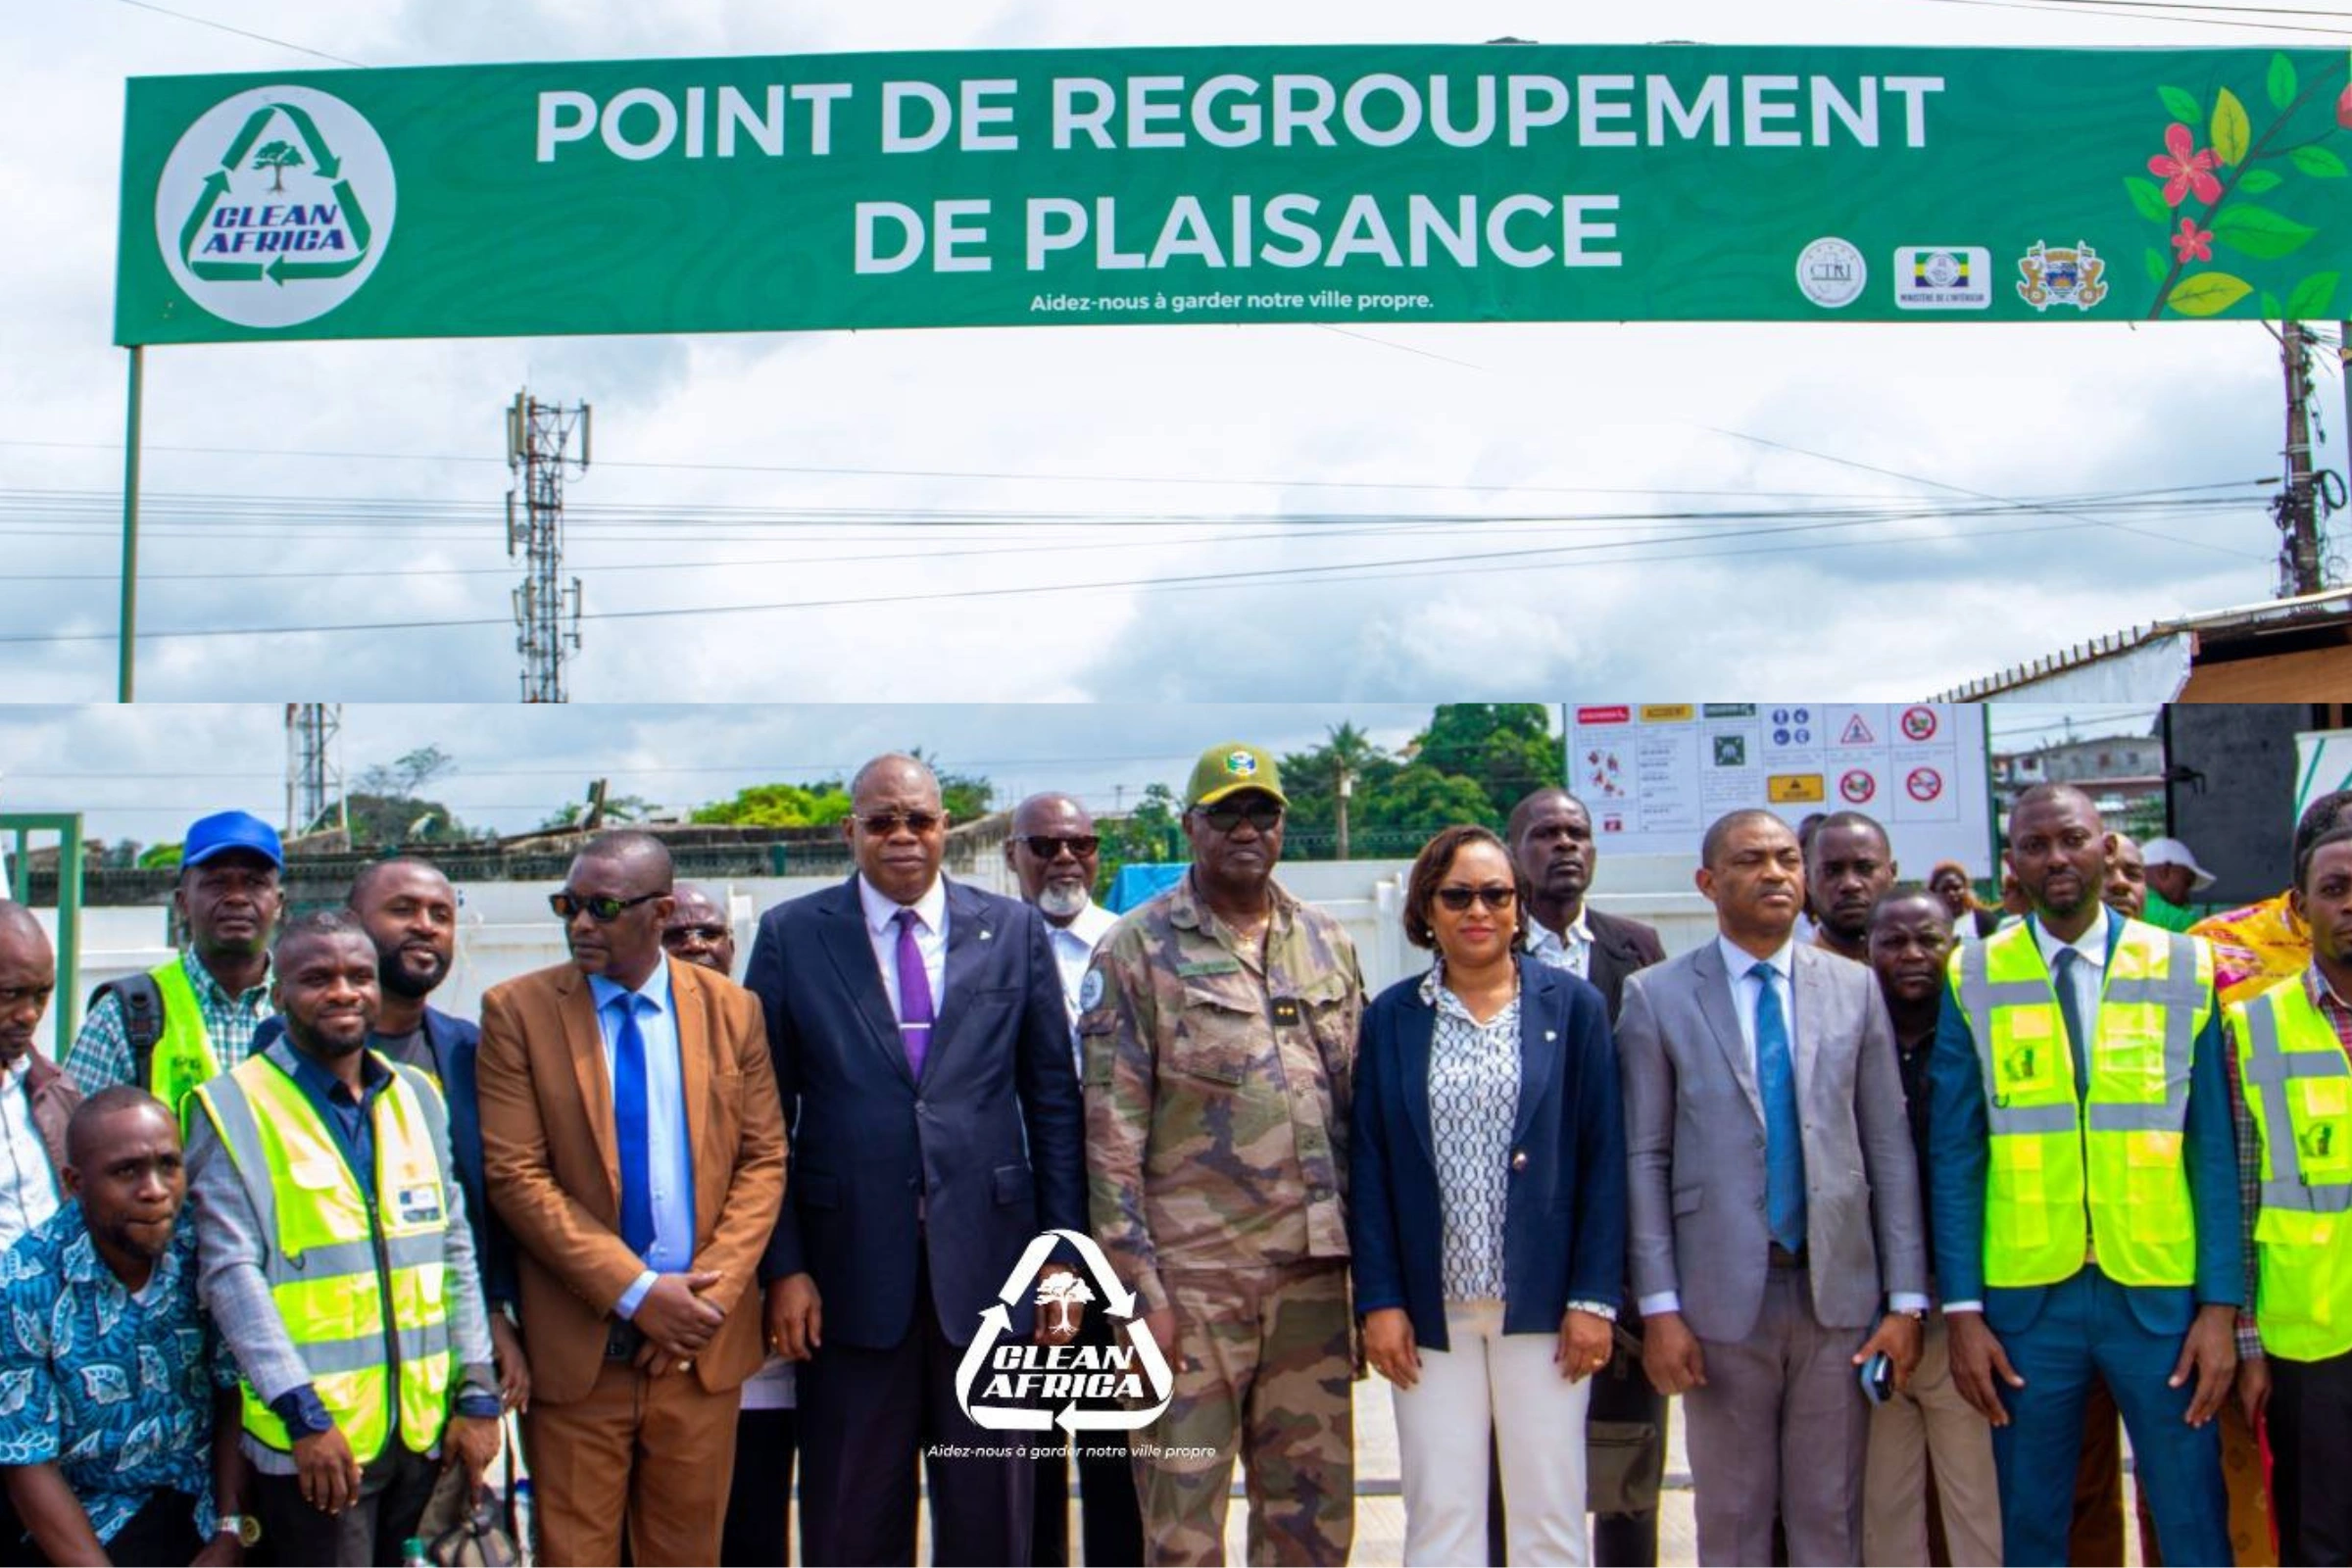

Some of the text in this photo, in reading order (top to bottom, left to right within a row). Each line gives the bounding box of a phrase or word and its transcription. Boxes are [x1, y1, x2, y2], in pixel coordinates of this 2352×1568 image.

[537, 73, 1945, 162] POINT DE REGROUPEMENT
[213, 204, 338, 228] CLEAN
[202, 229, 346, 254] AFRICA
[855, 193, 1623, 274] DE PLAISANCE
[1030, 290, 1434, 313] Aidez-nous à garder notre ville propre.
